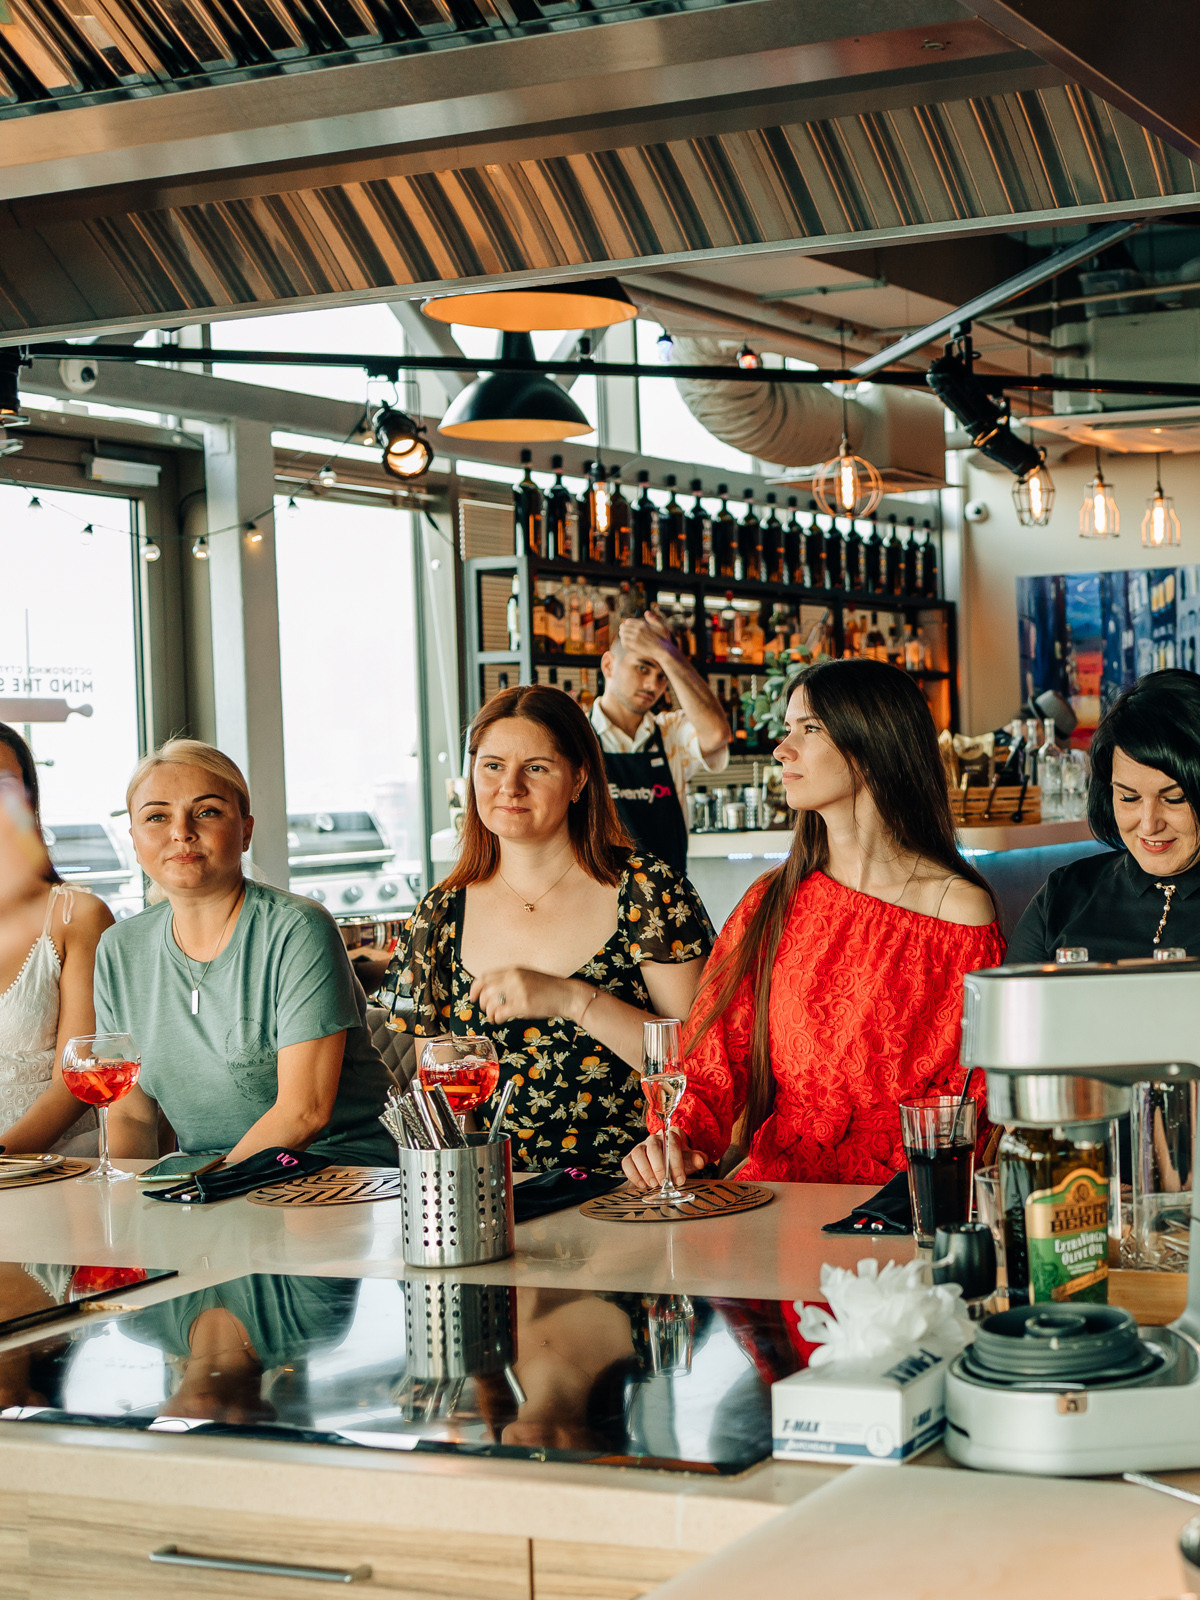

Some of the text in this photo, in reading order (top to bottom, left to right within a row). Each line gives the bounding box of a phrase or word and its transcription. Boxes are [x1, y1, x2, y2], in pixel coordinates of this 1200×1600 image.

[607, 783, 671, 803] EventyOn
[1061, 1243, 1104, 1266] OLIVE OIL
